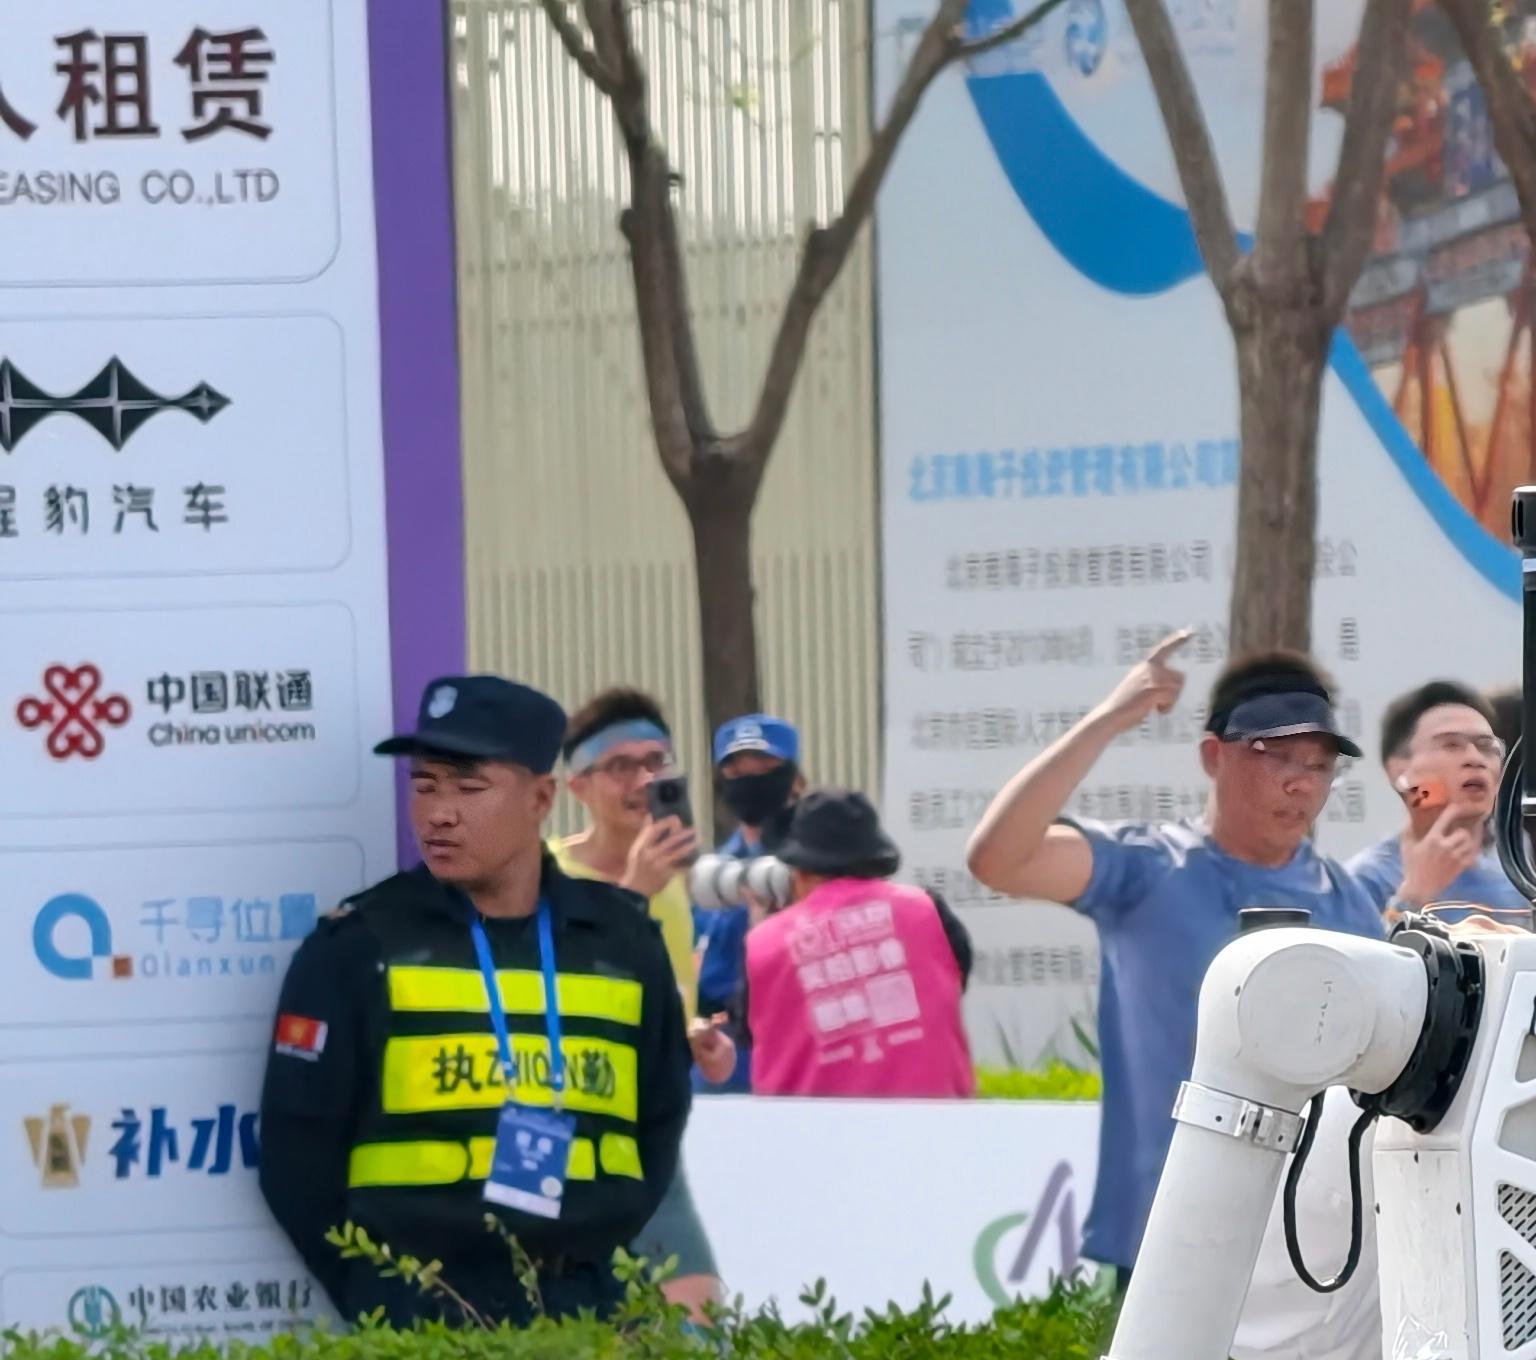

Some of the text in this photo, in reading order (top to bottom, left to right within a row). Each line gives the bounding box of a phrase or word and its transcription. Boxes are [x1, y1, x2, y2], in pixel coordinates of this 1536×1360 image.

[147, 669, 313, 715] 中国联通
[147, 722, 316, 748] China unicom
